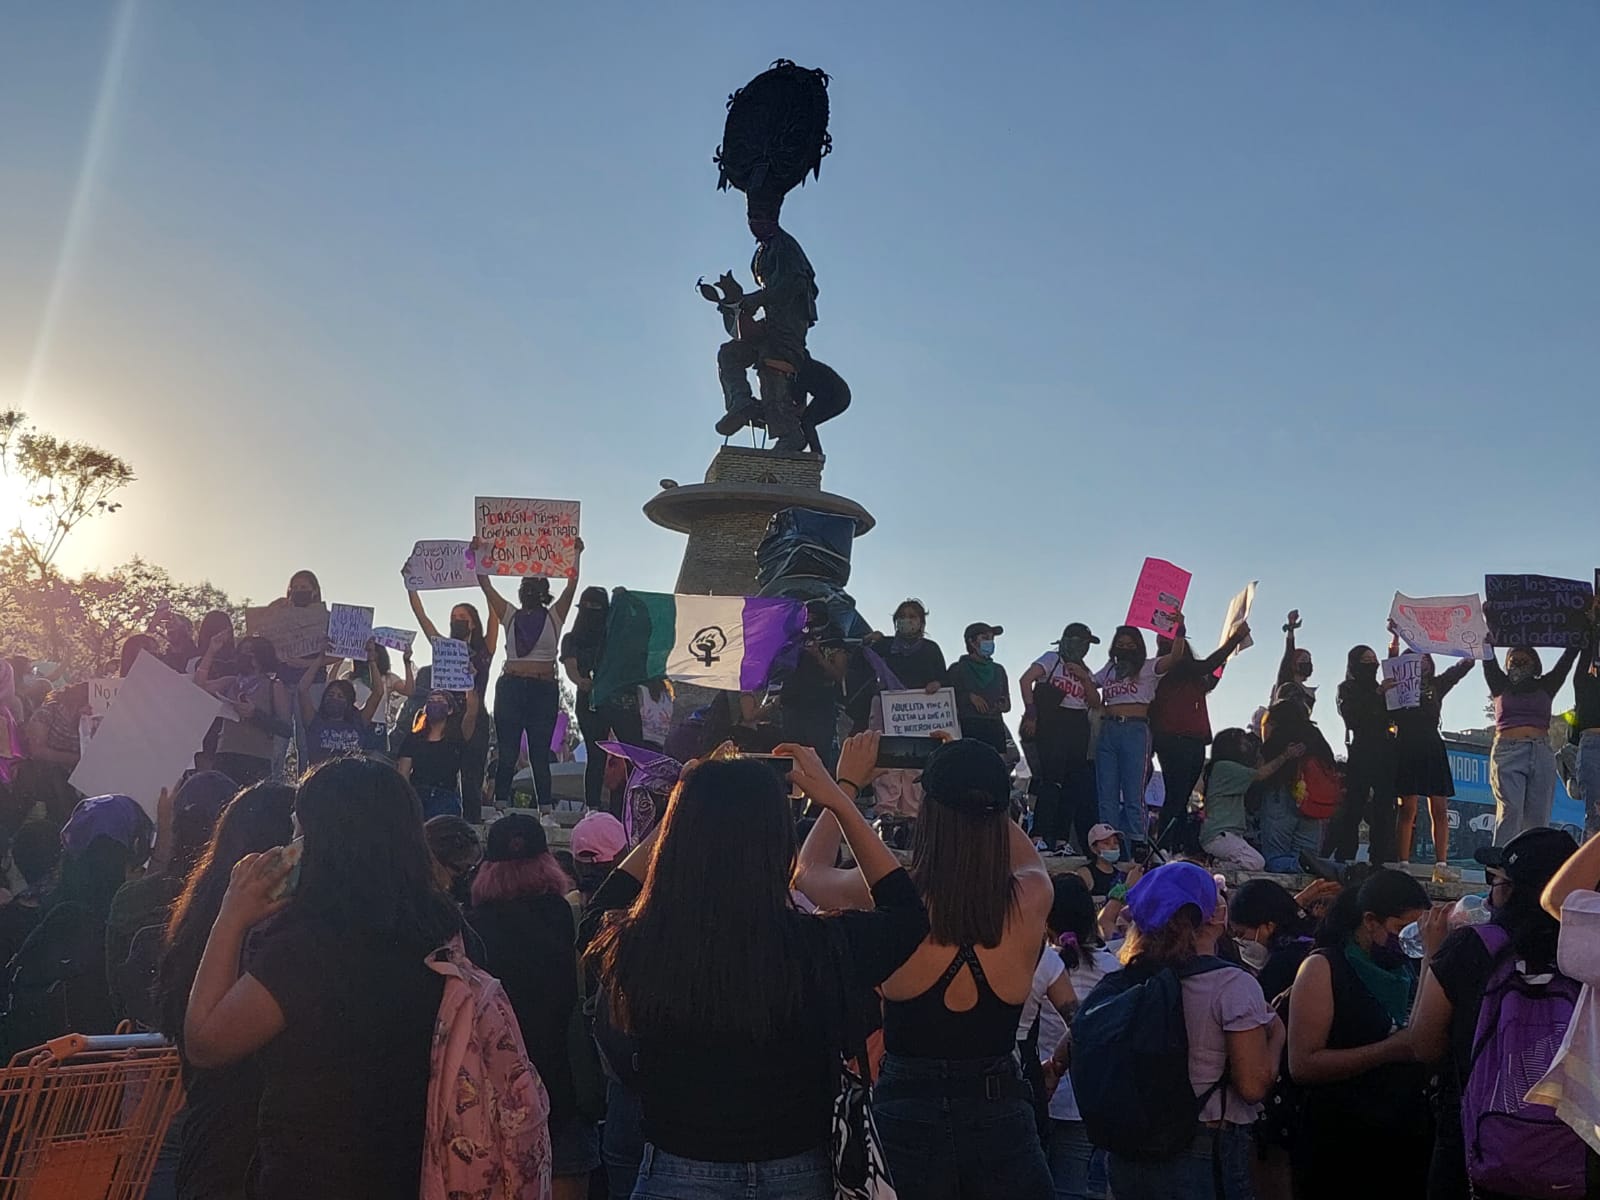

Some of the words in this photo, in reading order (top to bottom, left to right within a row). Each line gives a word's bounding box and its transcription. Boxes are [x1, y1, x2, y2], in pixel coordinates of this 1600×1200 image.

[491, 545, 515, 561] CON
[521, 544, 556, 561] AMOR
[424, 557, 444, 572] NO
[431, 569, 463, 582] VIVIR
[1524, 575, 1547, 592] los
[1555, 591, 1585, 609] NO
[1500, 609, 1567, 626] Cubran
[891, 702, 925, 713] ABUELITA
